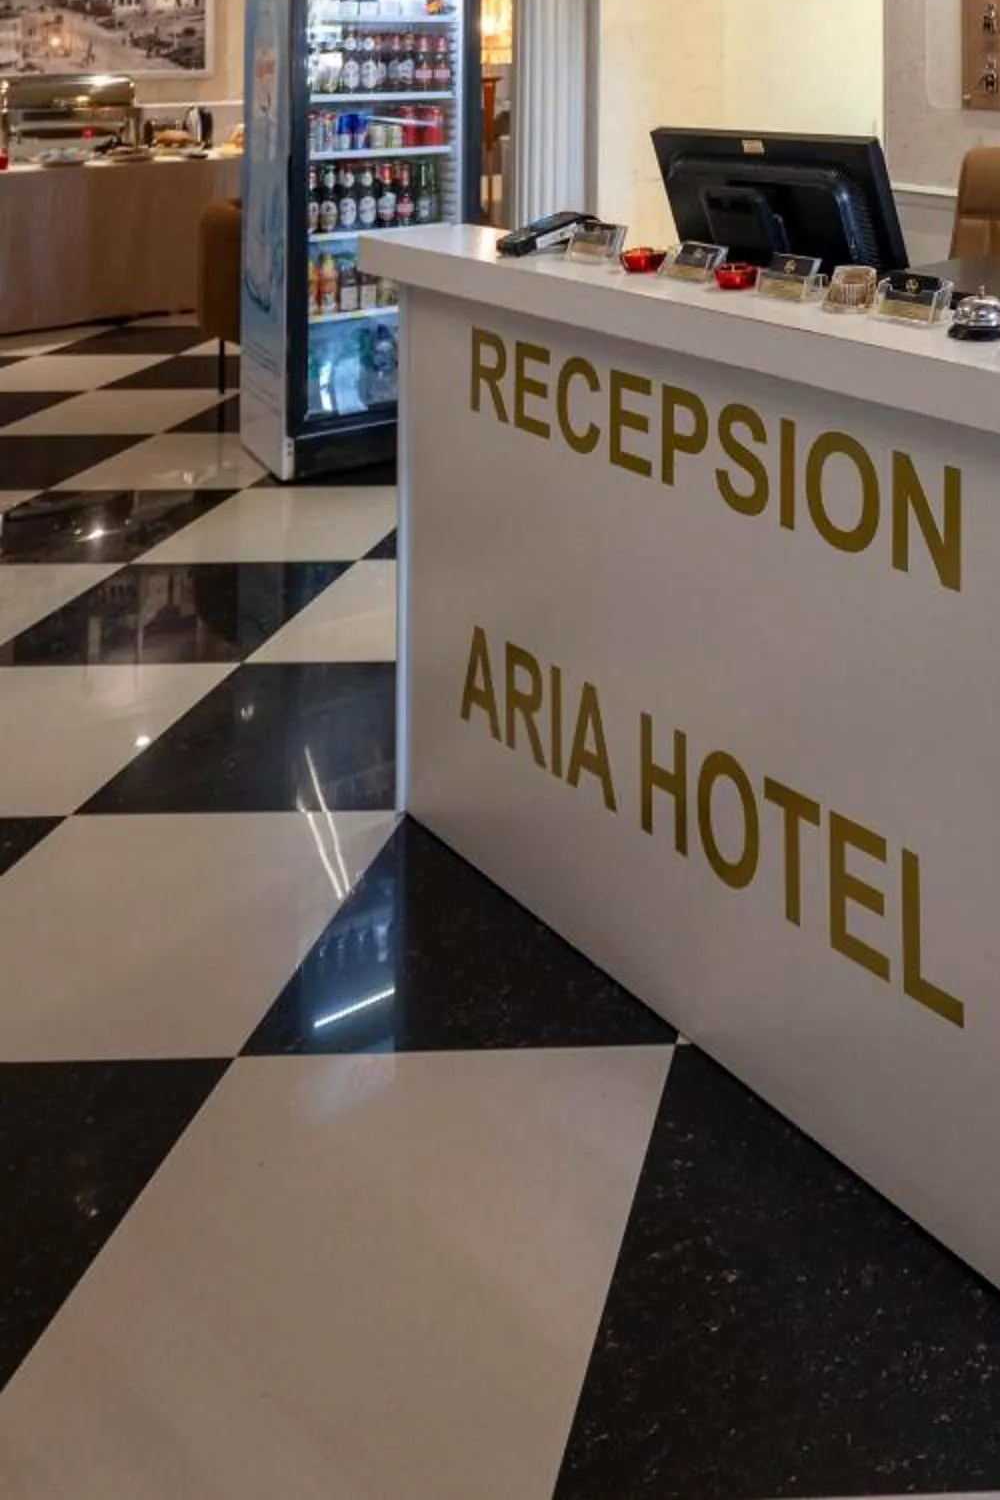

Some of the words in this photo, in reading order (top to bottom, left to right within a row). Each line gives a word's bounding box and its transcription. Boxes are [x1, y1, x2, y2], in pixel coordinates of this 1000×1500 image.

[469, 325, 962, 592] RECEPSION
[460, 625, 617, 813] ARIA
[639, 711, 965, 1028] HOTEL
